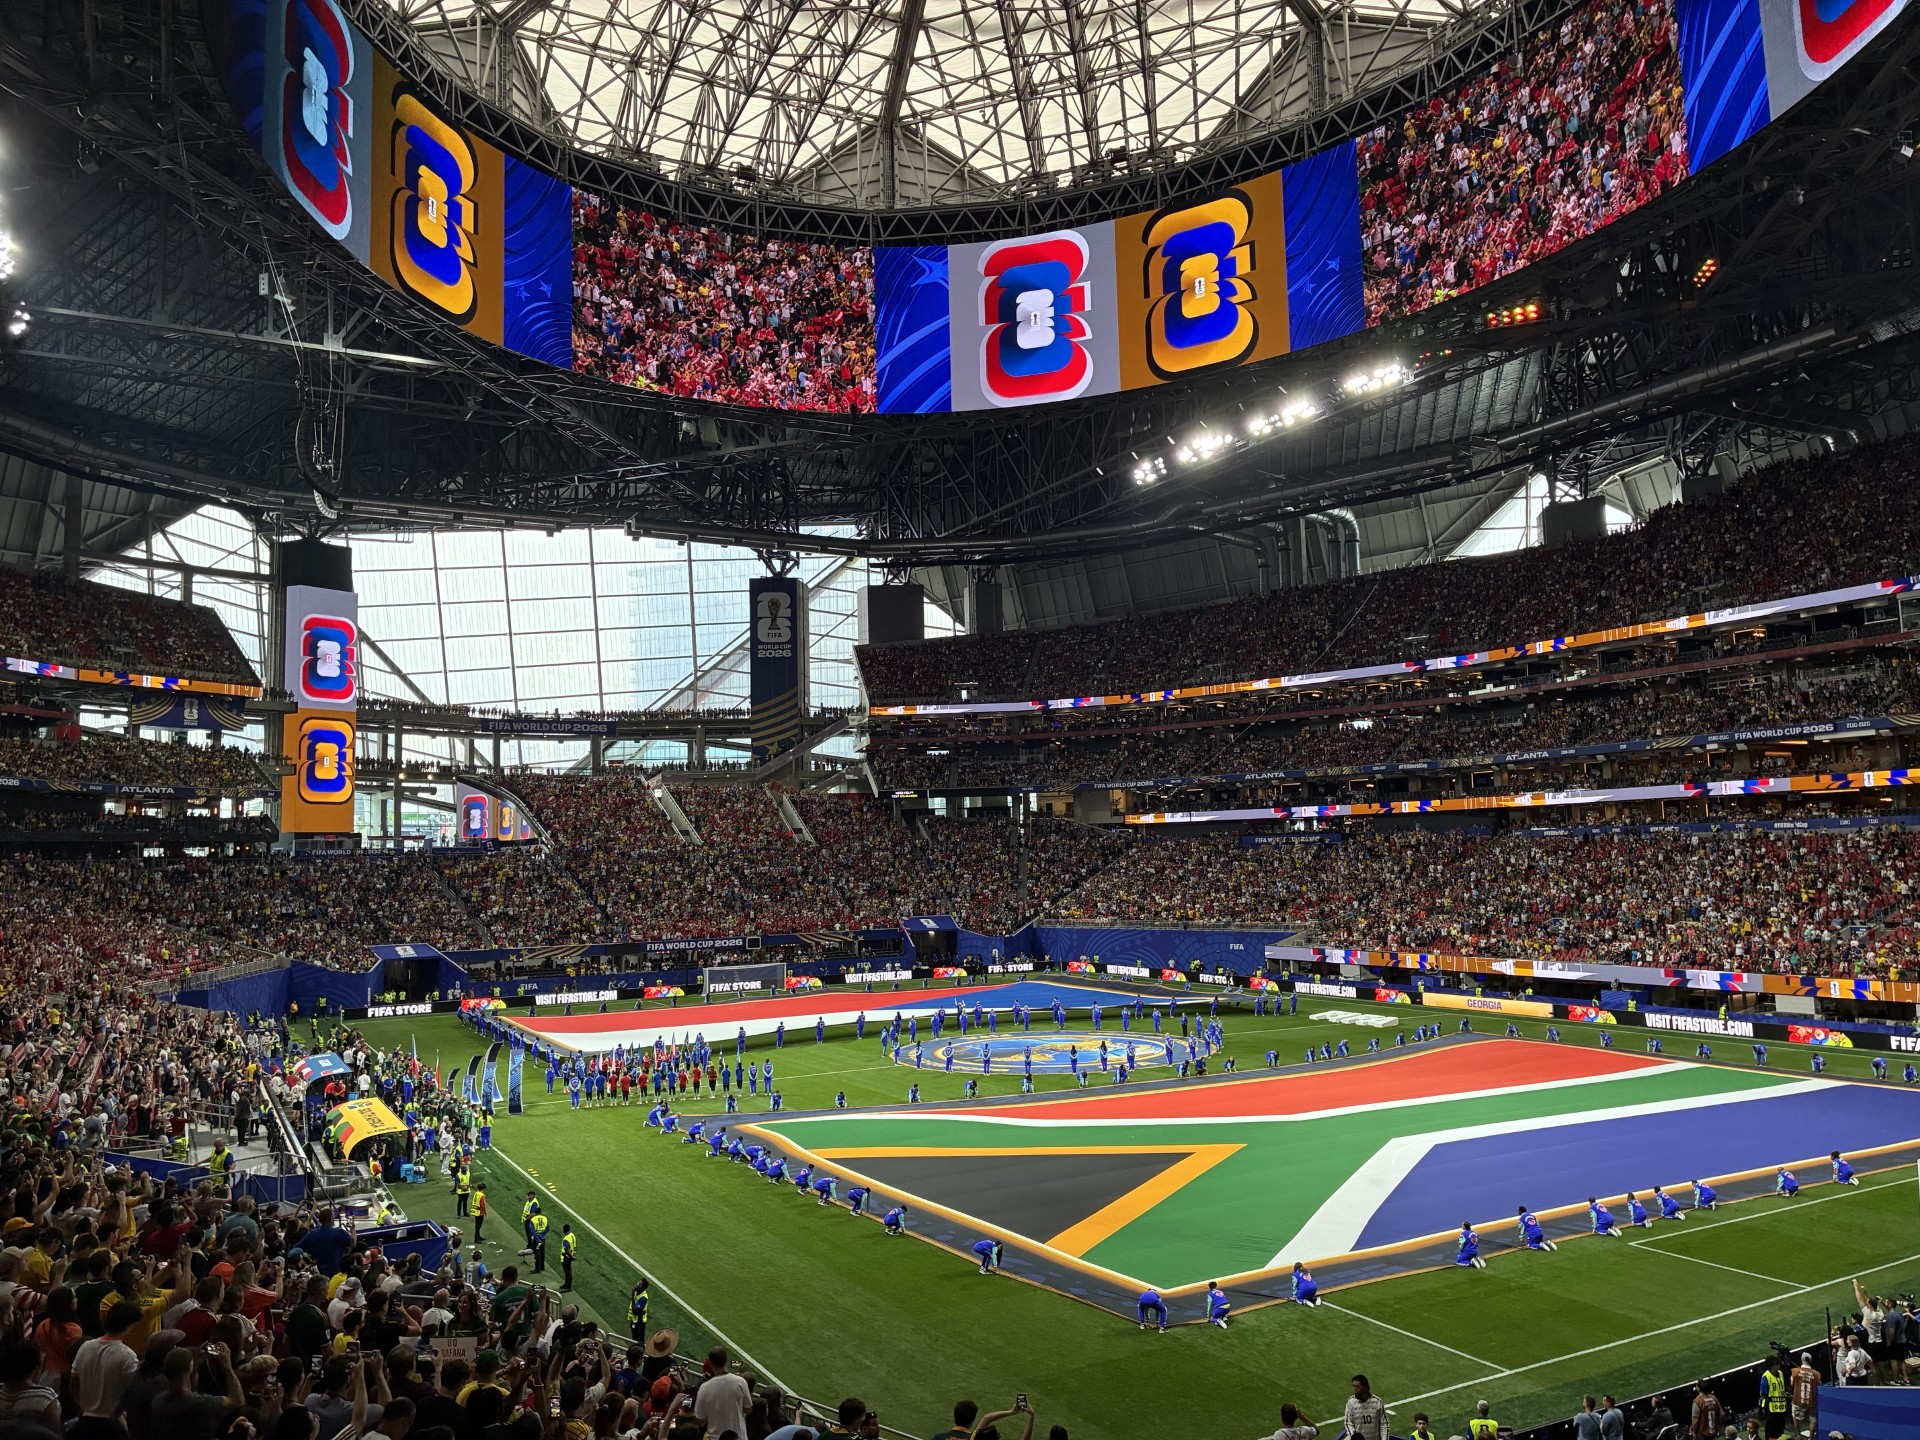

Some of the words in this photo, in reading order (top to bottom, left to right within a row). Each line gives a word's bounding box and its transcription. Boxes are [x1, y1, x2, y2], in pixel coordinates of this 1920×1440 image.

[489, 721, 511, 730] FIFA
[513, 722, 550, 731] WORLD
[551, 723, 571, 731] CUP
[572, 723, 608, 732] 2026
[1735, 732, 1752, 741] FIFA
[1752, 729, 1784, 739] WORLD
[1784, 727, 1801, 736] CUP
[1802, 723, 1834, 733] 2026
[1244, 772, 1285, 780] ATLANTA
[0, 778, 20, 786] 2026
[120, 786, 175, 794] ATLANTA
[646, 943, 664, 951] FIFA
[666, 940, 696, 950] WORLD
[697, 940, 714, 948] CUP
[715, 939, 743, 947] 2026
[1008, 963, 1034, 973] STORE
[845, 973, 862, 983] VISIT
[862, 970, 912, 982] FIFASTORE.COM
[732, 980, 762, 991] STORE
[1295, 982, 1311, 993] VISIT
[1311, 983, 1357, 998] FIFASTORE.COM
[535, 994, 556, 1006] VISIT
[557, 990, 618, 1004] FIFASTORE.COM
[396, 1003, 432, 1015] STORE
[1467, 998, 1502, 1010] GEORGIA
[1645, 1013, 1670, 1028] VISIT
[1672, 1017, 1754, 1038] FIFASTORE.COM
[447, 1338, 457, 1347] GO
[1362, 1414, 1372, 1424] 10
